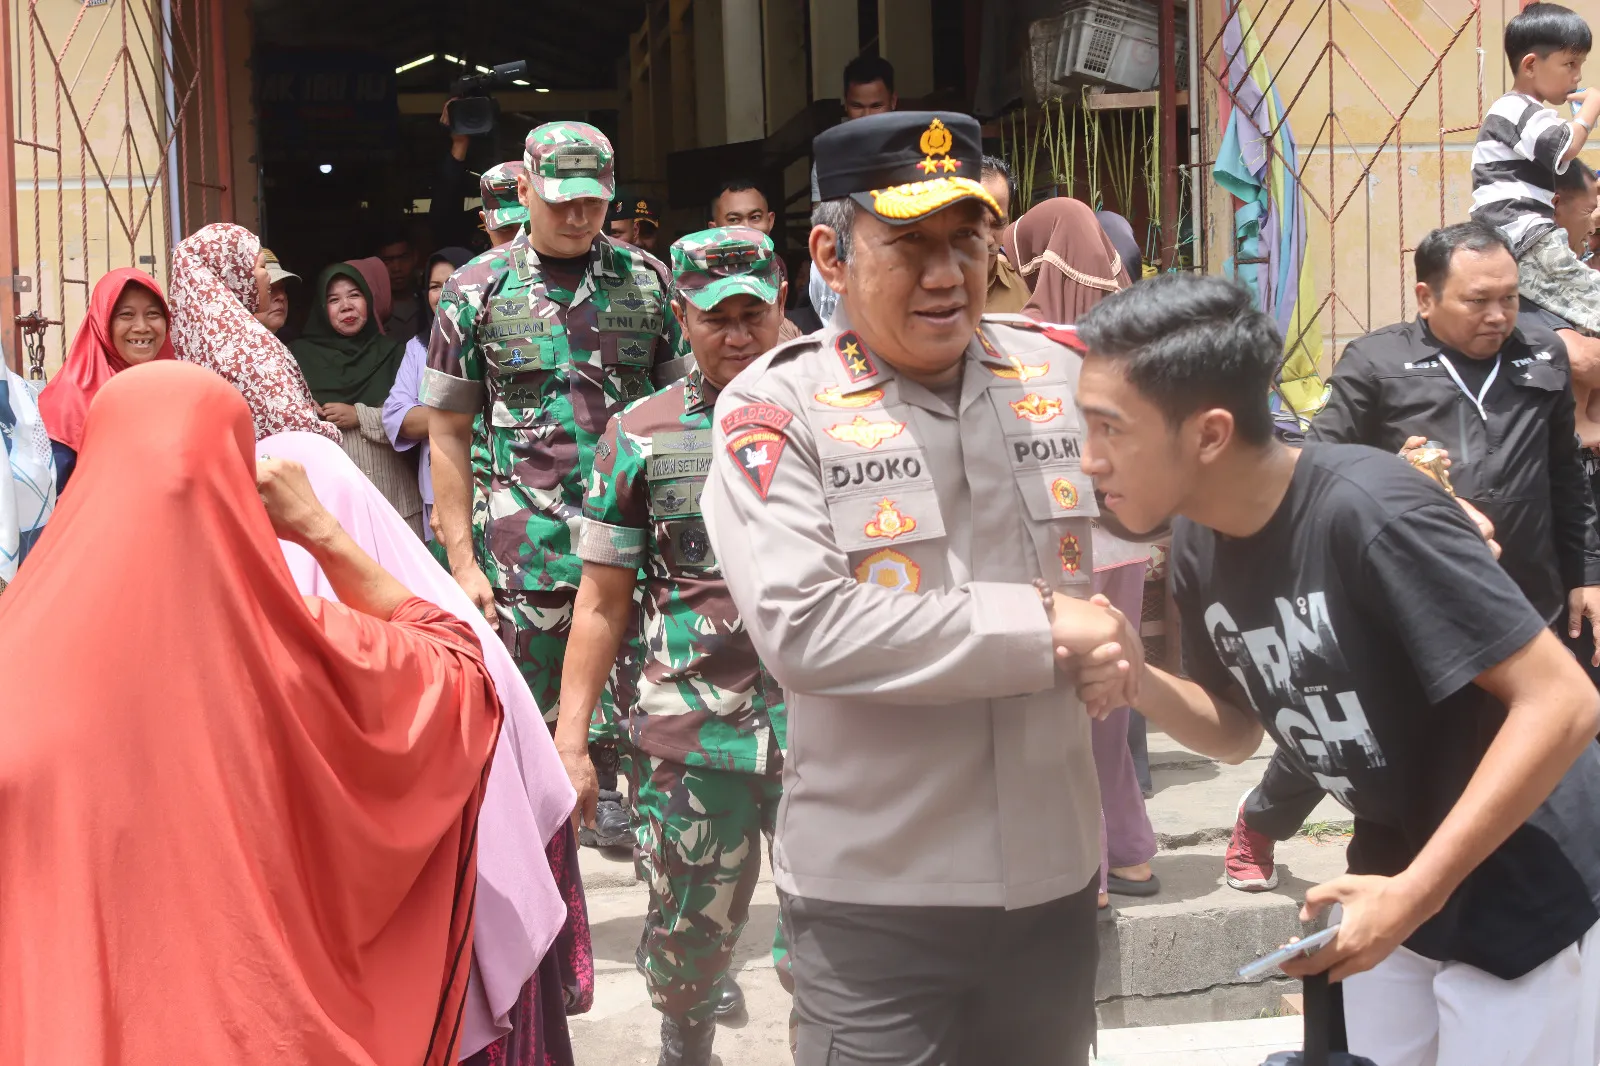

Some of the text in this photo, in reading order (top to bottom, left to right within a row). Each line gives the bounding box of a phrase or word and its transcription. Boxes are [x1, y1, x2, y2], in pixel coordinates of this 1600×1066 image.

[484, 321, 544, 341] MILLIAN
[605, 317, 658, 331] TNI AD
[725, 406, 786, 429] PELOPOR
[1013, 437, 1081, 463] POLRI
[831, 456, 921, 488] DJOKO
